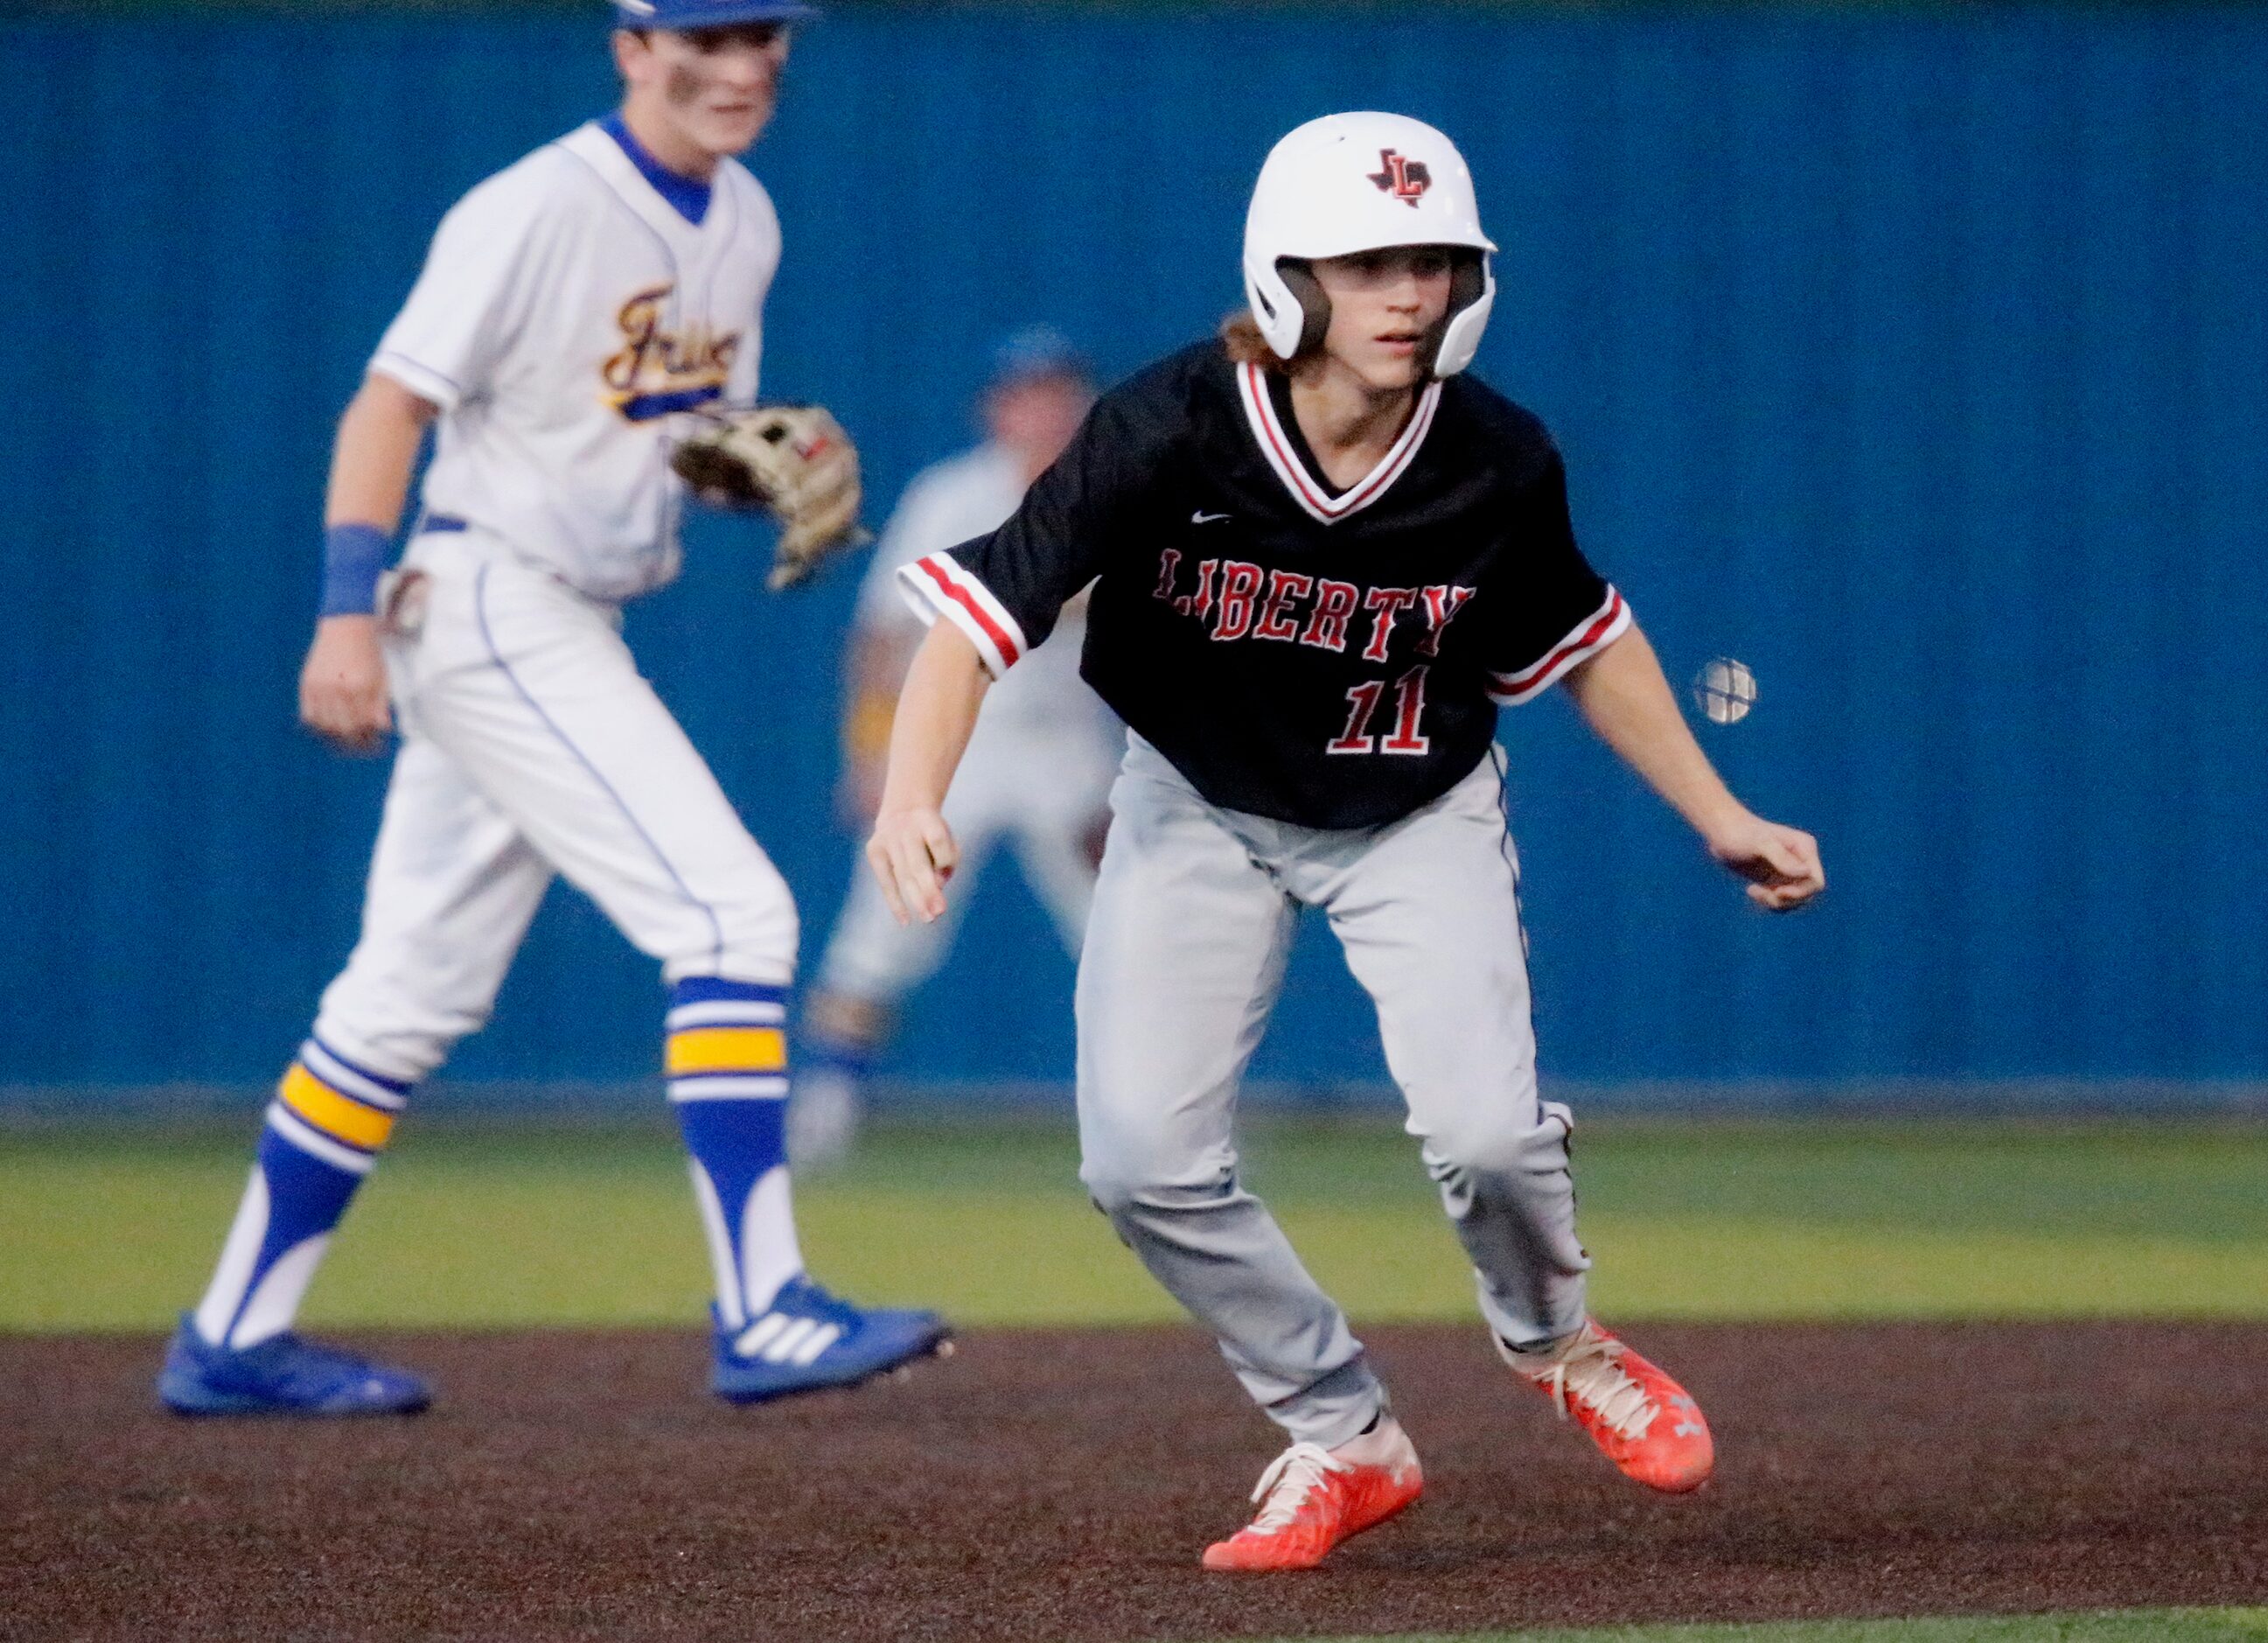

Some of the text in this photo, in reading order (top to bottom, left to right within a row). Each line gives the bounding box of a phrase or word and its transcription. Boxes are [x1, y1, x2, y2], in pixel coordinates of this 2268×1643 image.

[1388, 155, 1424, 199] L
[1153, 548, 1477, 663] LIBERTY
[1326, 664, 1431, 757] 11
